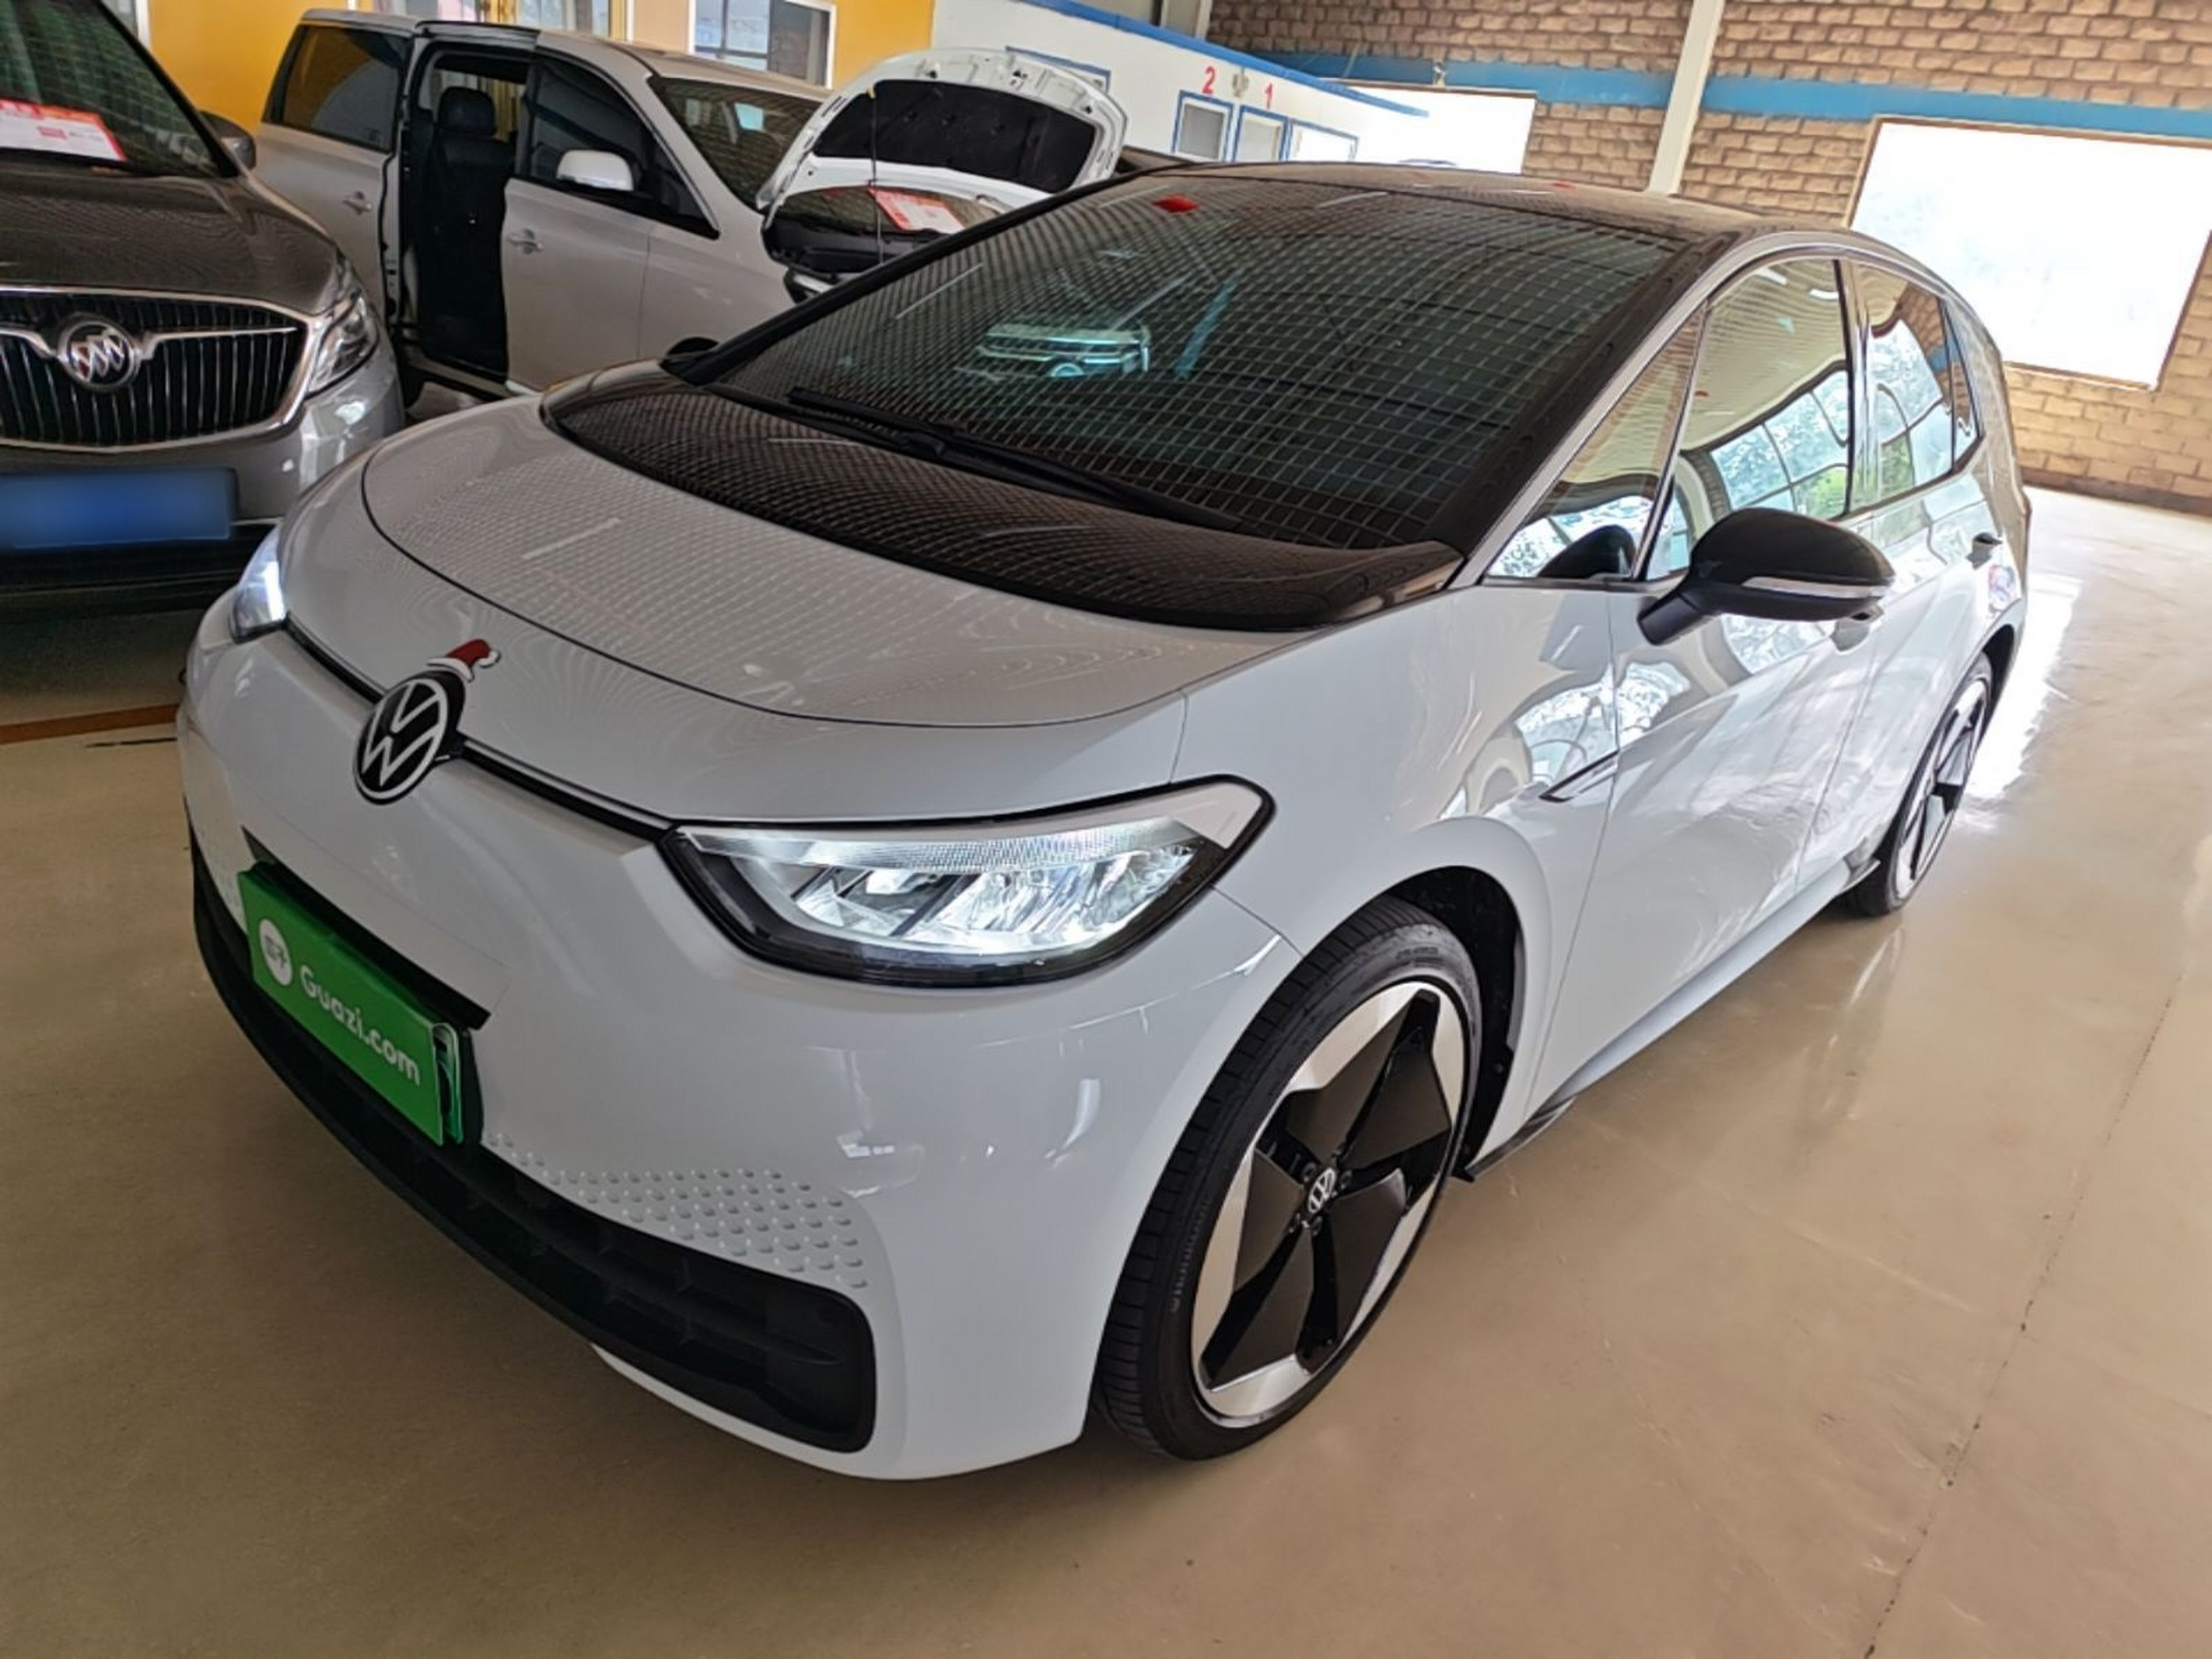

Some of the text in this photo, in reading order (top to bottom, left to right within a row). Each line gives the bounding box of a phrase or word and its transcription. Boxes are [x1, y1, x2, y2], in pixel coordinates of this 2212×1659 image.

[1202, 66, 1216, 95] 2
[1264, 82, 1273, 110] 1
[356, 678, 448, 800] VW
[301, 964, 421, 1086] Guazi.com
